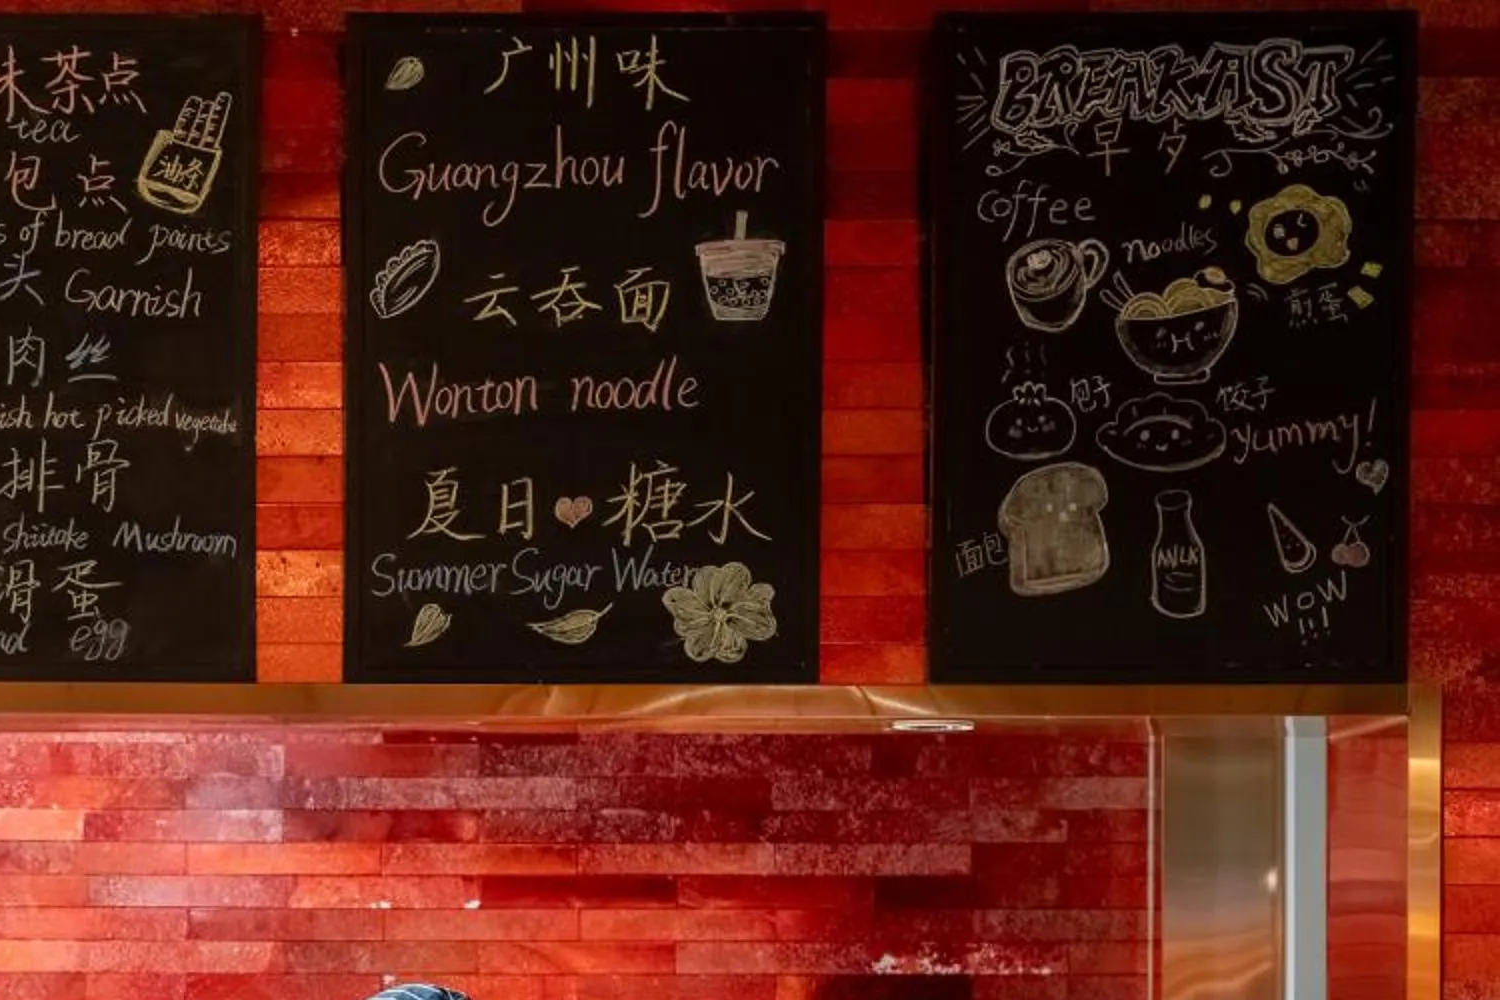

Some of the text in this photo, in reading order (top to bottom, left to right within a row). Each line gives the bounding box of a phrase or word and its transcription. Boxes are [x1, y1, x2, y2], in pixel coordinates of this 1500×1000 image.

[484, 34, 692, 112] 广州味
[7, 118, 81, 144] tea
[379, 120, 780, 228] Guangzhou flavor
[19, 210, 50, 256] of
[54, 208, 133, 251] bread
[65, 266, 202, 319] Garnish
[464, 266, 672, 333] 云吞面
[378, 355, 701, 428] Wonton noodle
[69, 617, 132, 661] egg
